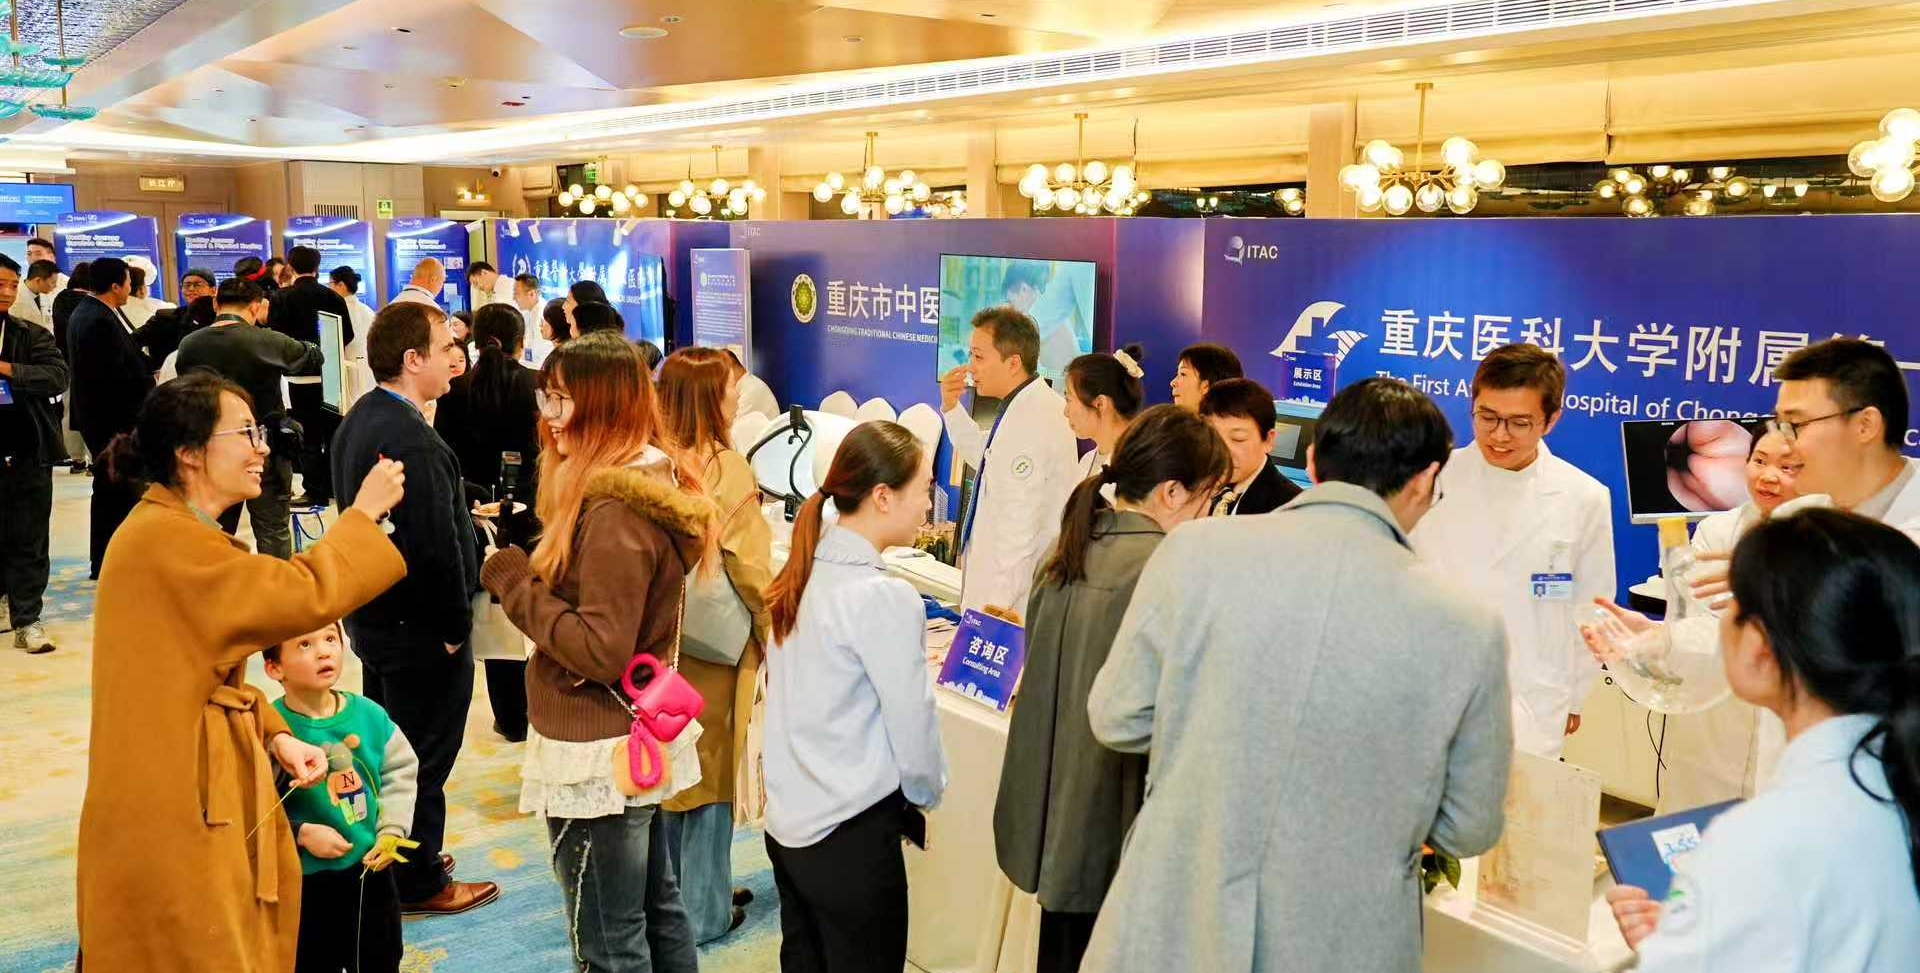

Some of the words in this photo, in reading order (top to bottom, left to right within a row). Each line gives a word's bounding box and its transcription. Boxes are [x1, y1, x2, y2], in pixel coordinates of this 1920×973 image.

[1247, 244, 1278, 260] ITAC
[1293, 367, 1323, 381] 展示区
[1413, 374, 1449, 396] First
[1645, 397, 1671, 420] of
[968, 635, 1009, 665] 咨询区
[962, 656, 989, 676] Consulting
[987, 666, 1001, 678] Area
[341, 771, 355, 788] N
